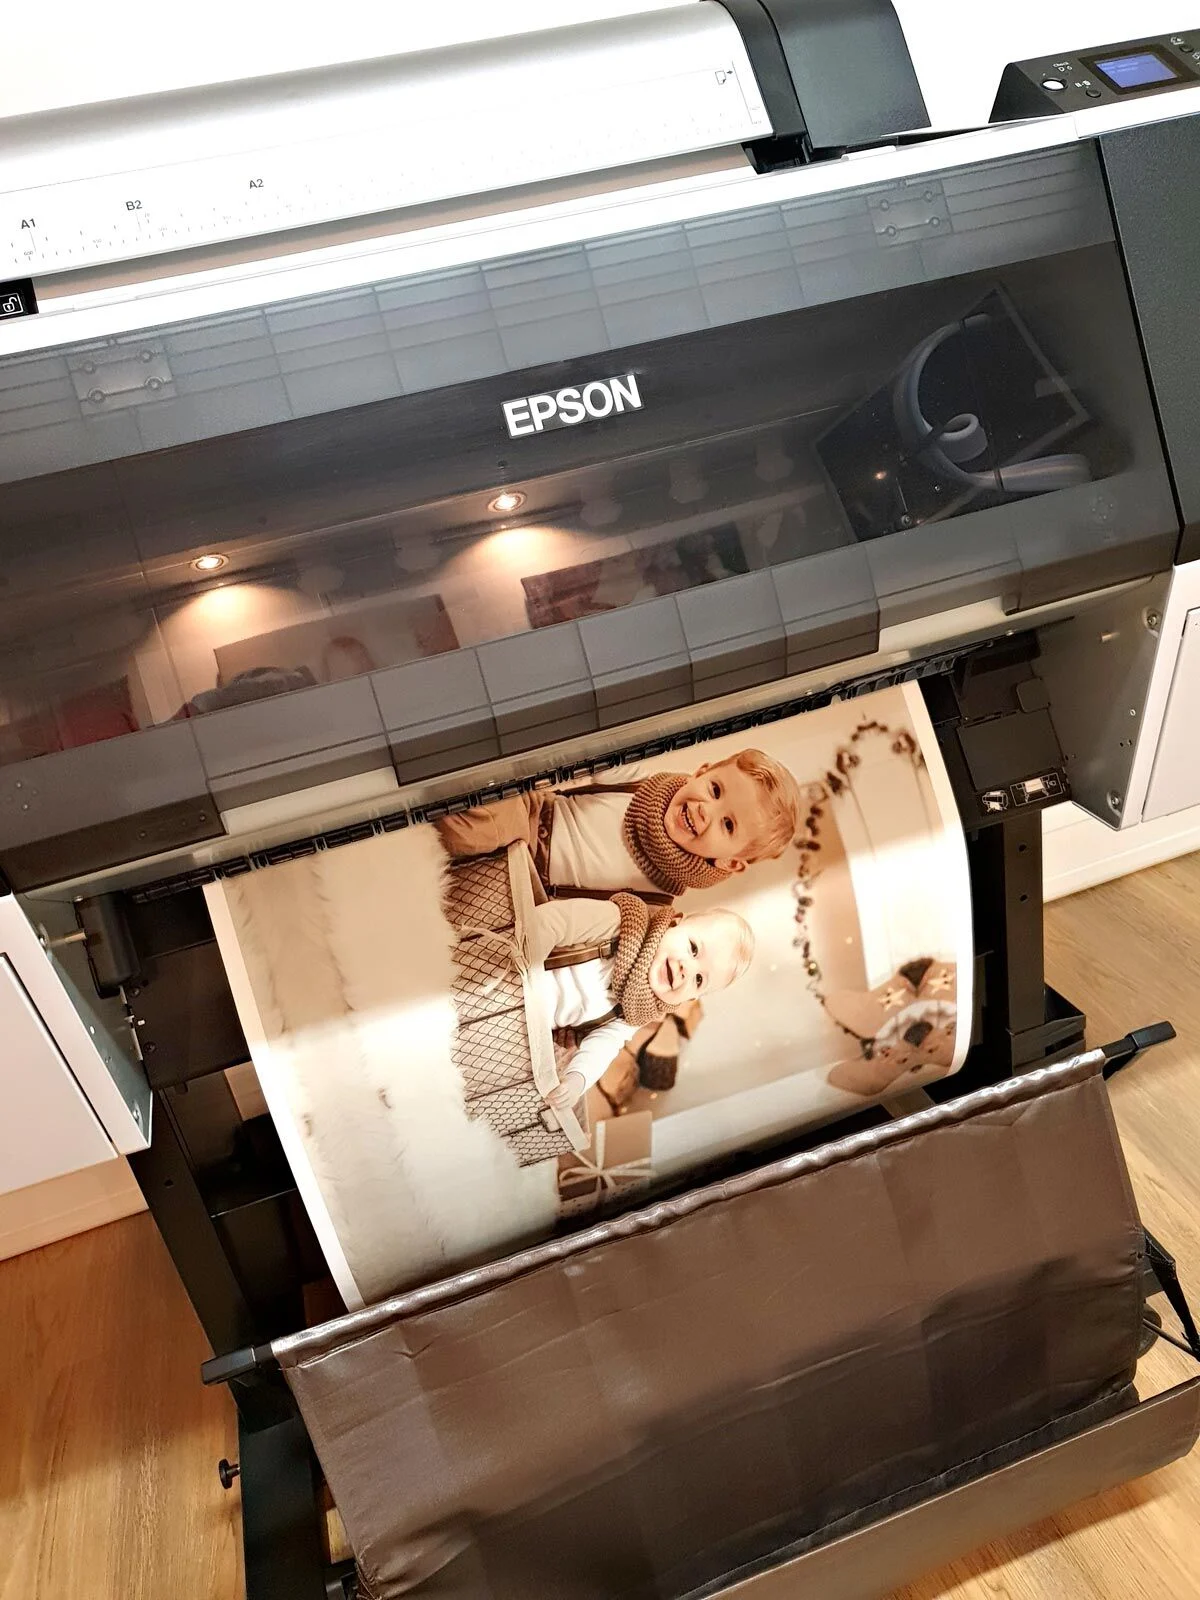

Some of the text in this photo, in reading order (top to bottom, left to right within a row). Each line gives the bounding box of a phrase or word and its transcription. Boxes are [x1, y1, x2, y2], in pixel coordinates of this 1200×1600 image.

[249, 178, 265, 190] A2
[125, 199, 143, 211] B2
[20, 218, 36, 230] A1
[502, 374, 642, 437] EPSON
